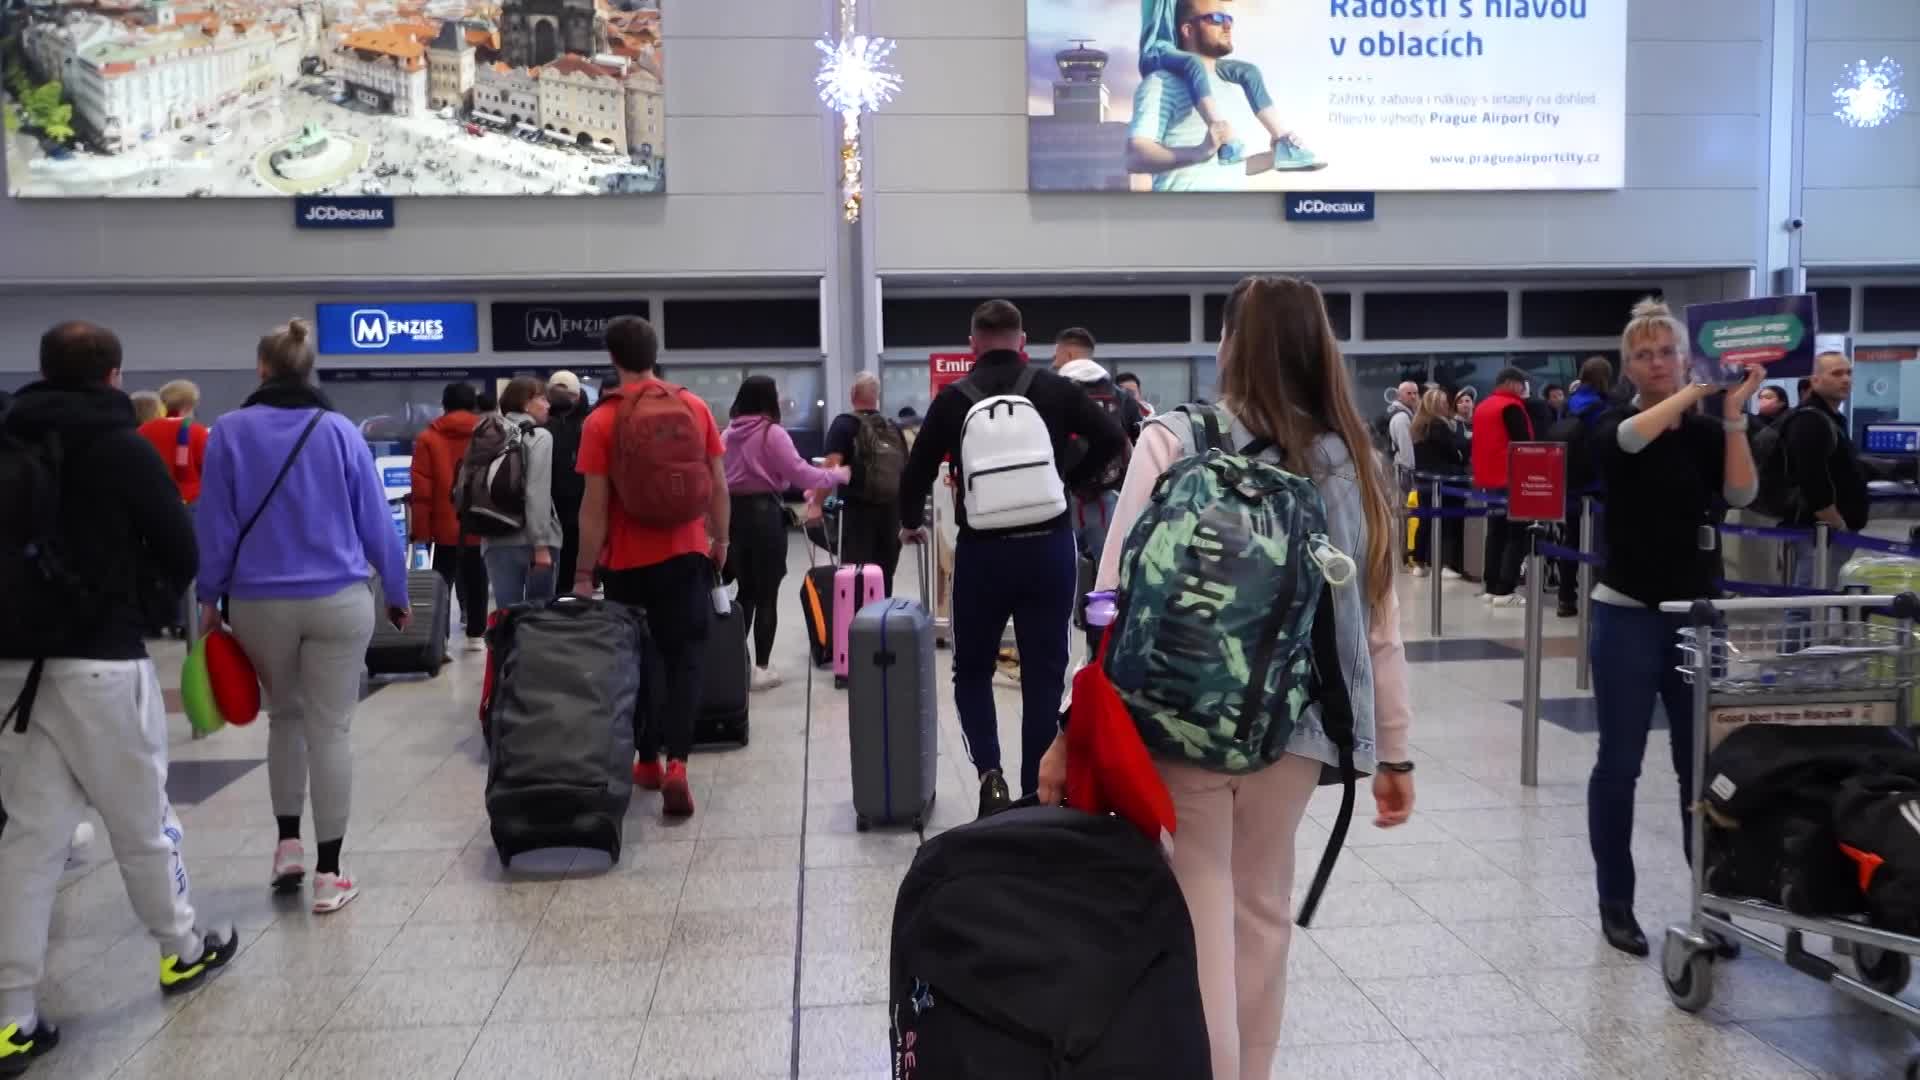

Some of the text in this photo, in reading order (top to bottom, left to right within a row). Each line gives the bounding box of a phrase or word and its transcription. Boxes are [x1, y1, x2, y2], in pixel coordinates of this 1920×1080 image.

[1330, 0, 1586, 18] Radosti s hlavou
[1329, 29, 1484, 57] v oblacích
[1430, 111, 1478, 126] Prague
[1482, 111, 1529, 126] Airport
[1533, 111, 1560, 127] City
[1430, 152, 1600, 166] www.pragueairportcity.cz
[304, 205, 385, 220] JCDecaux
[1294, 199, 1367, 214] JCDecaux
[354, 316, 443, 342] MENZIES
[531, 316, 608, 338] MENZIE
[936, 357, 976, 372] Emir
